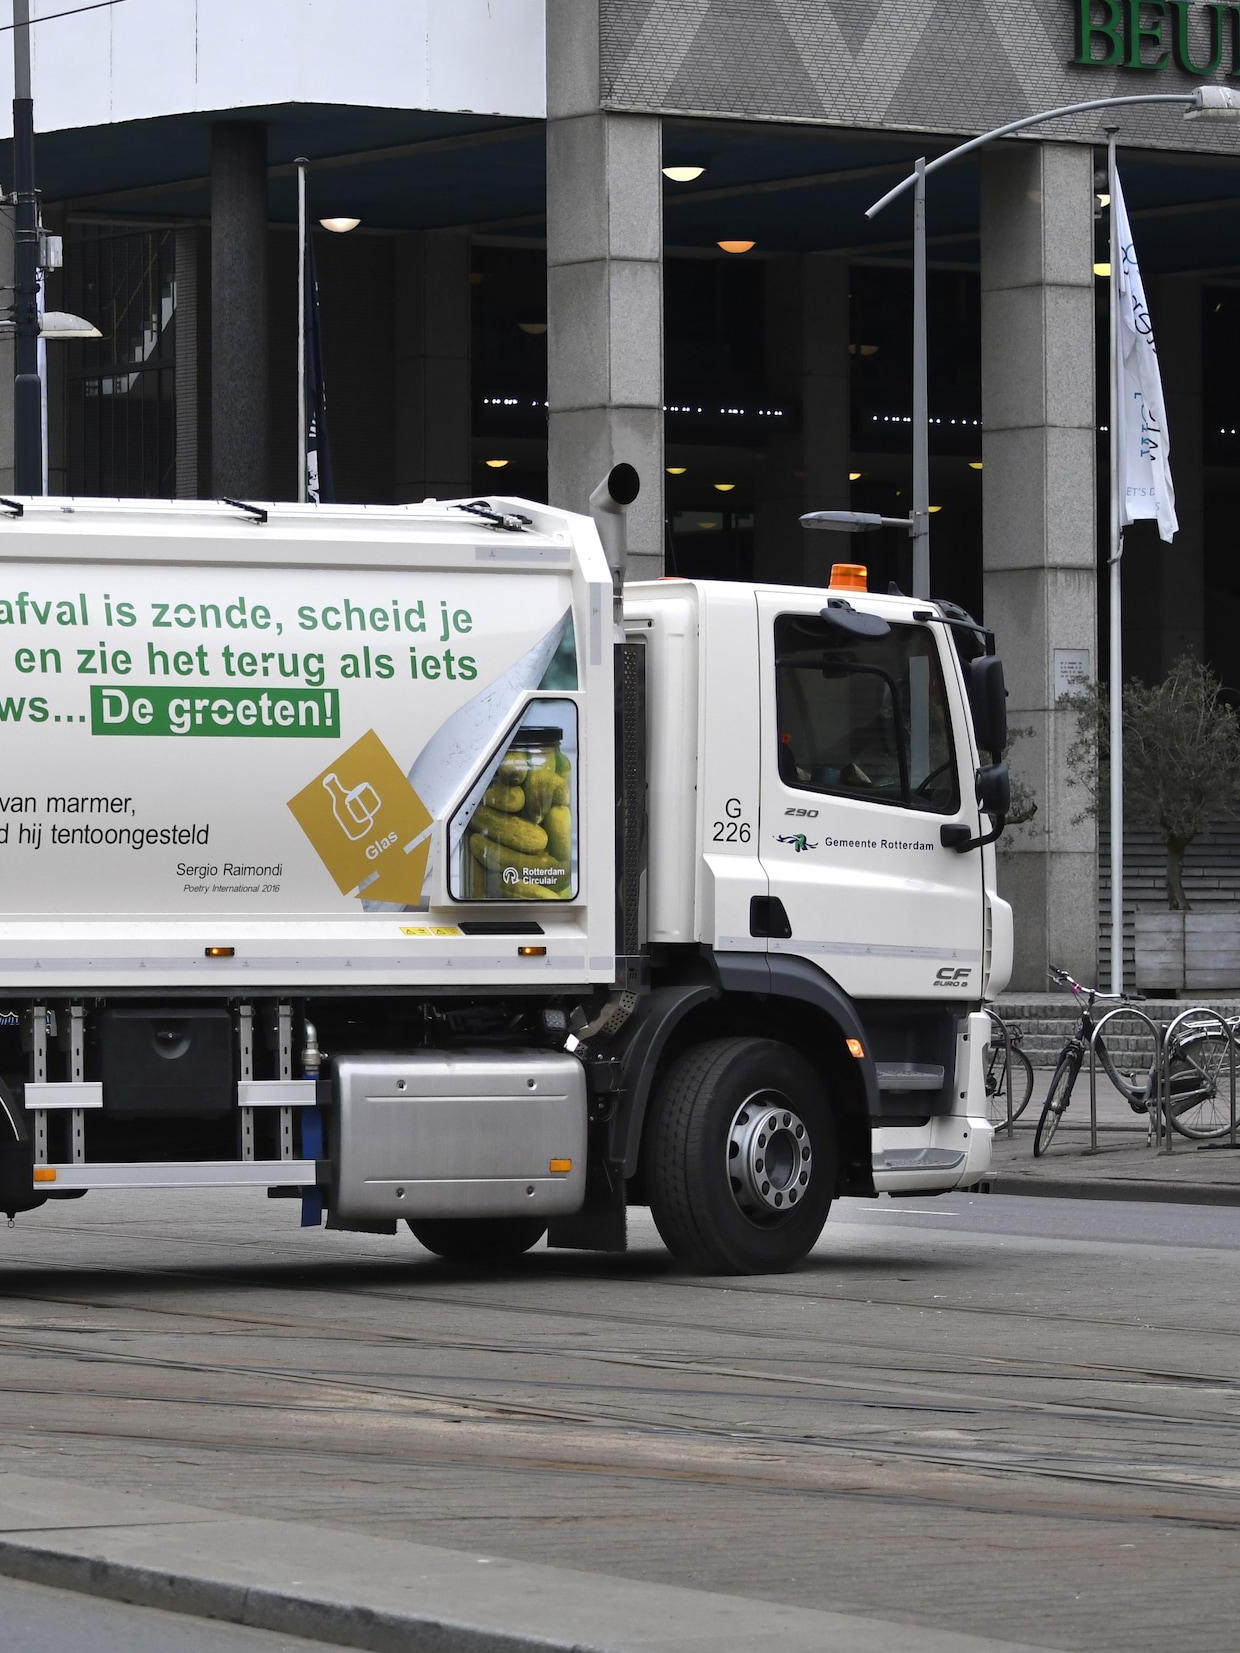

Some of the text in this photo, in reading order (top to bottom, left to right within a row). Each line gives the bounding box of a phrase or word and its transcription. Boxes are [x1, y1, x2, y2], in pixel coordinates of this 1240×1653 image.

[1070, 0, 1240, 76] BEU
[1126, 486, 1147, 497] ET'S
[103, 593, 137, 627] is
[151, 596, 283, 636] zonde,
[297, 598, 427, 633] scheid
[439, 600, 473, 641] je
[14, 646, 62, 674] en
[76, 641, 132, 675] zie
[147, 641, 210, 676] het
[221, 644, 325, 687] terug
[339, 645, 395, 680] als
[409, 646, 478, 681] iets
[101, 688, 154, 725] De
[167, 692, 333, 735] groeten!
[46, 796, 136, 817] marmer,
[725, 798, 742, 819] G
[784, 807, 819, 818] 290
[18, 822, 42, 850] hij
[51, 823, 209, 850] tentoongesteld
[712, 821, 751, 843] 226
[365, 831, 398, 860] Glas
[825, 836, 934, 851] Gemeente Rotterdam
[176, 862, 283, 880] Sergio Raimondi
[522, 867, 565, 876] Rotterdam
[522, 876, 558, 885] Circulair
[183, 884, 281, 894] Poetry International 2016
[935, 967, 972, 980] CF
